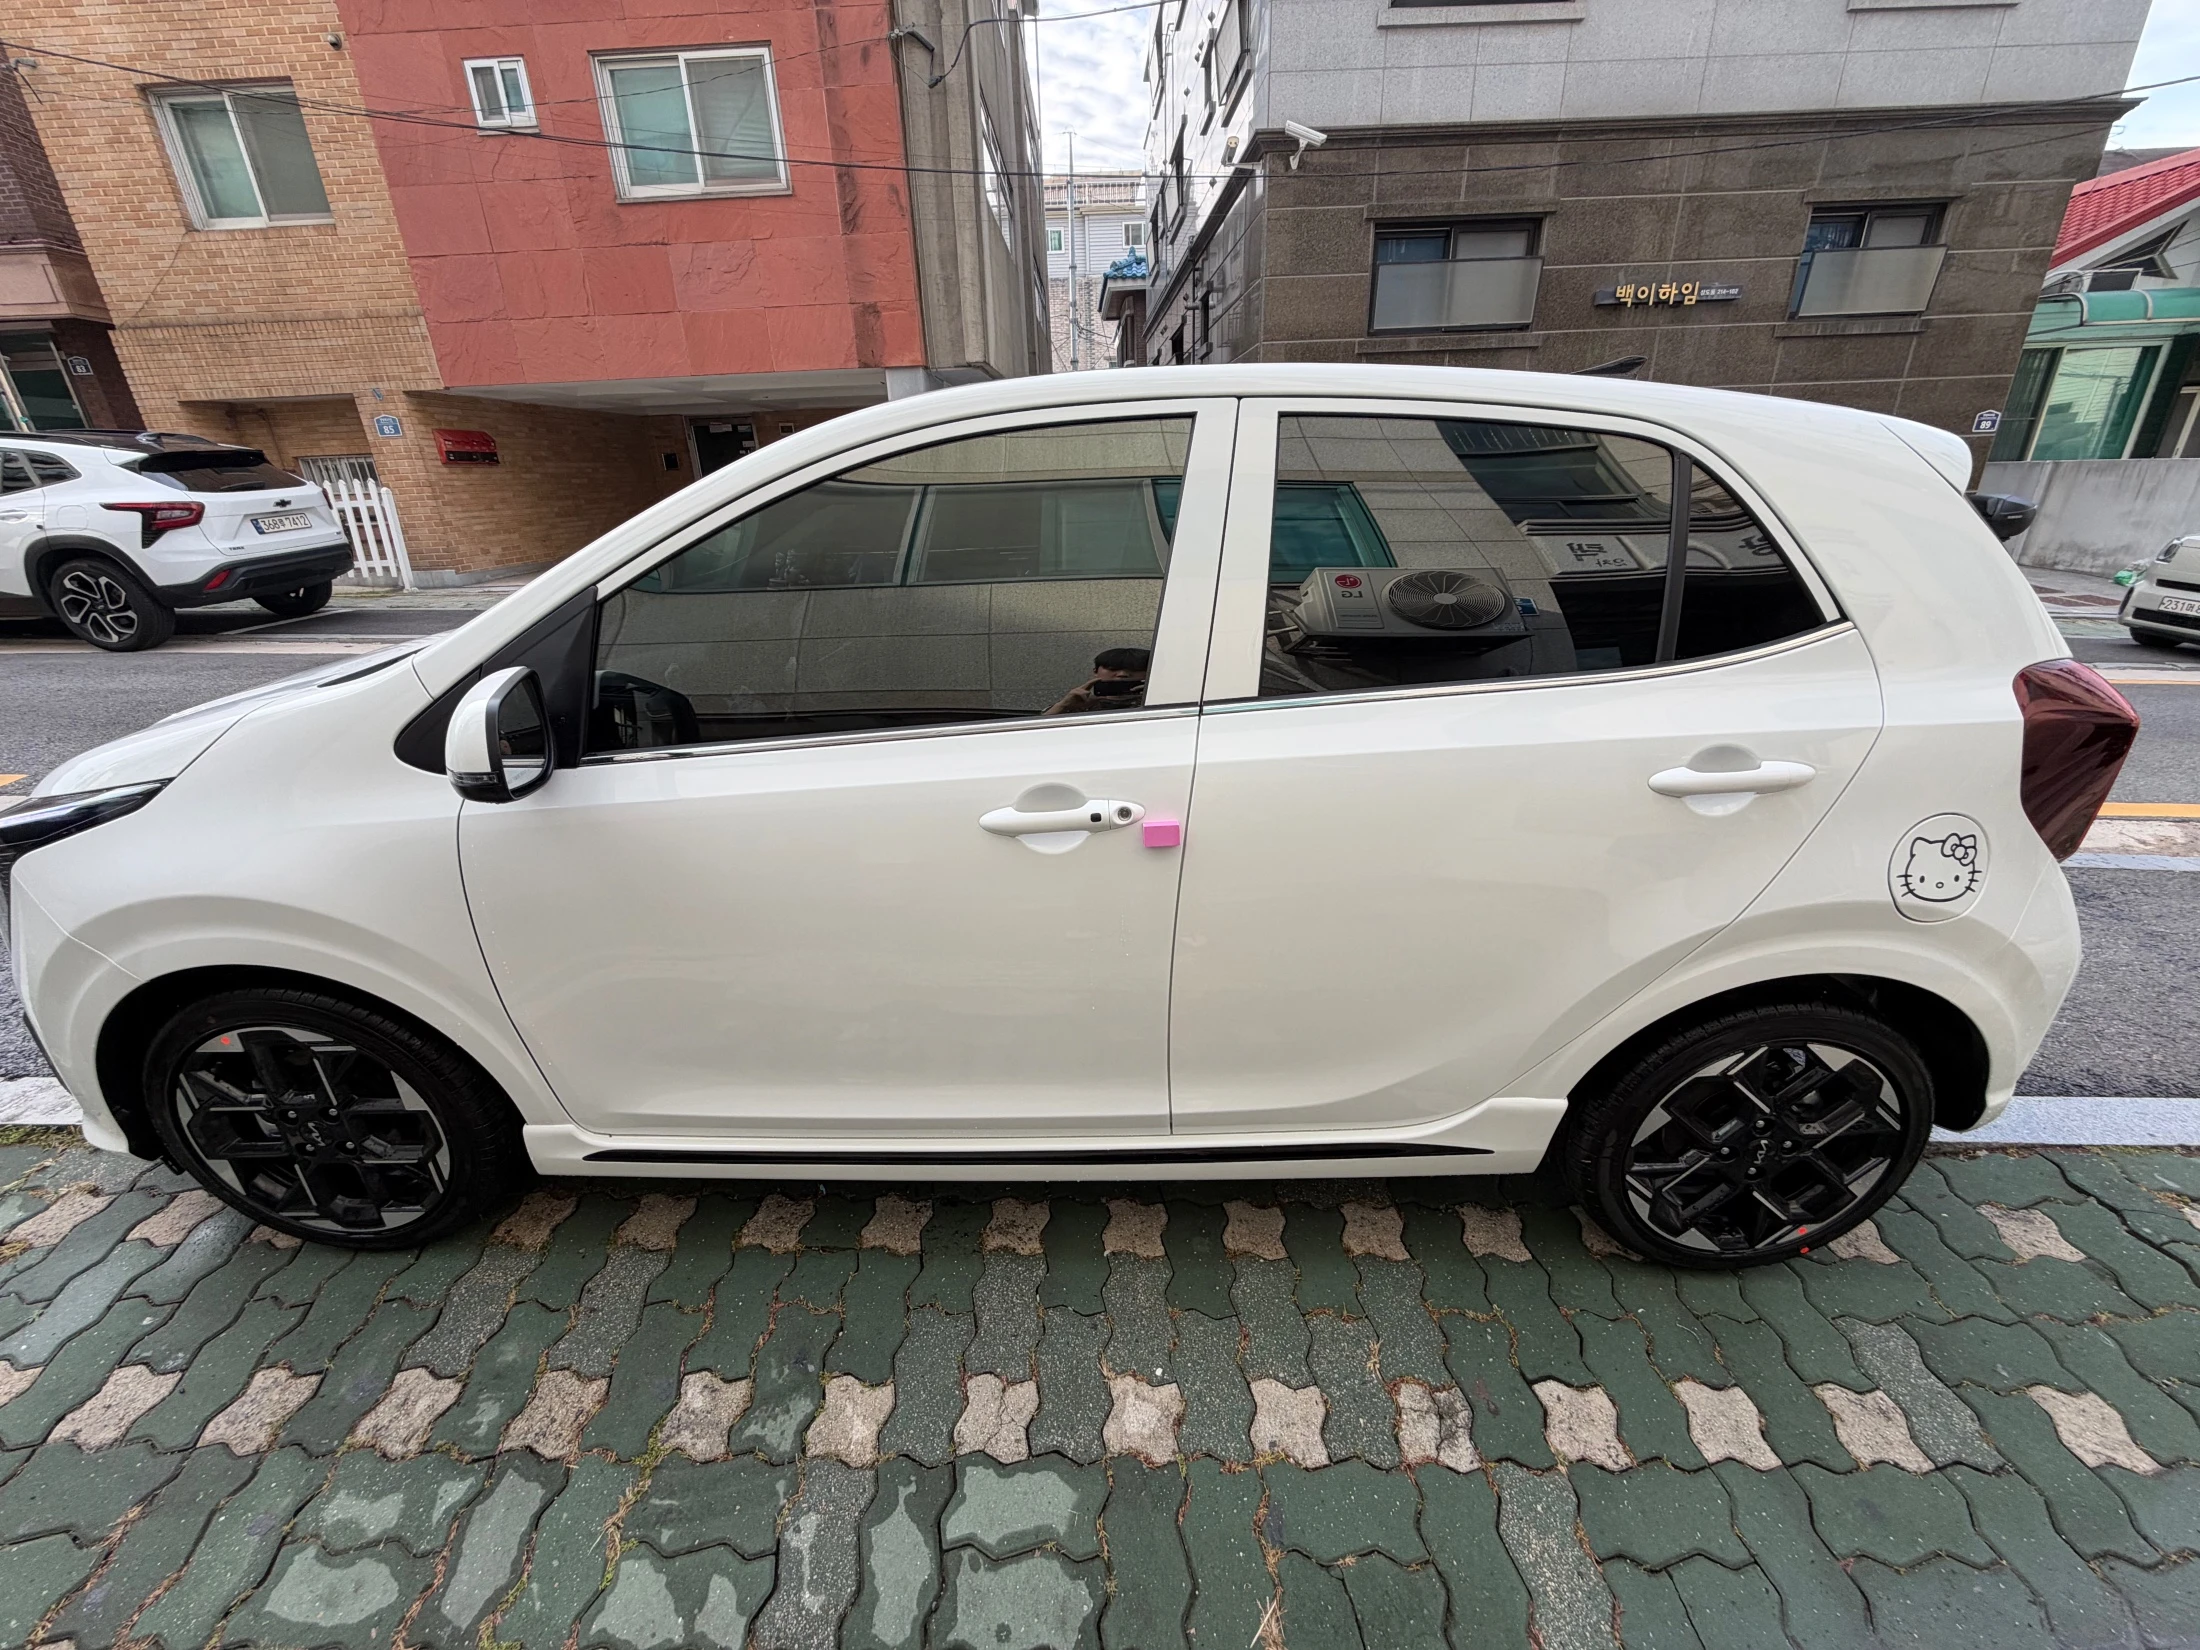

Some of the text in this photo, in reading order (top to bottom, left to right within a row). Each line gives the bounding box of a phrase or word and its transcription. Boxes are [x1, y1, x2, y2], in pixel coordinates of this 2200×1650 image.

[1616, 281, 1699, 307] 백이하임
[1980, 420, 1992, 429] 89
[383, 425, 395, 434] 85
